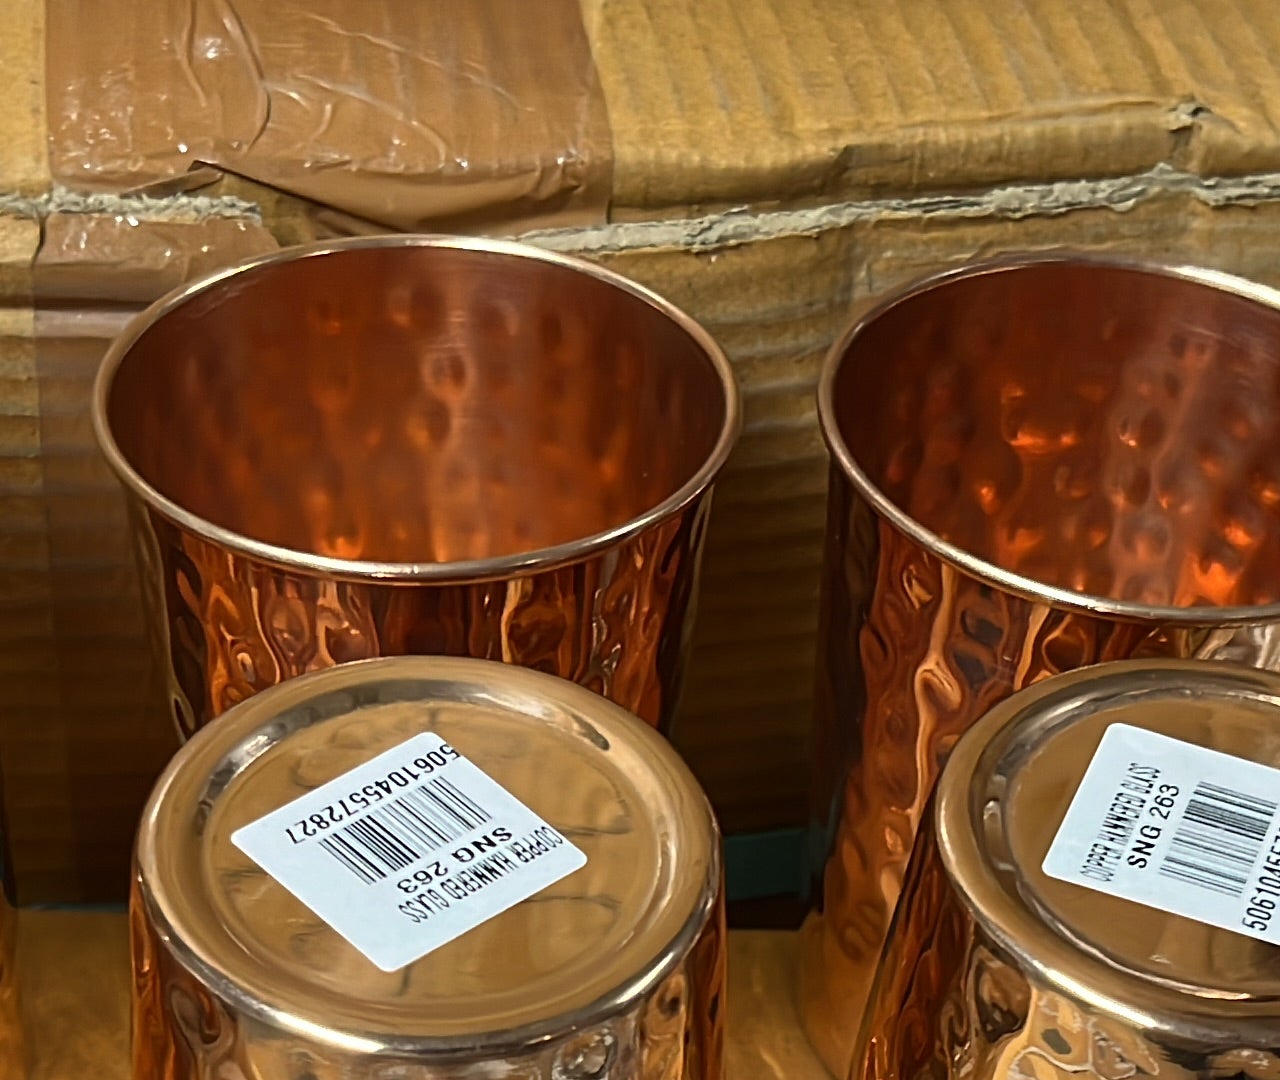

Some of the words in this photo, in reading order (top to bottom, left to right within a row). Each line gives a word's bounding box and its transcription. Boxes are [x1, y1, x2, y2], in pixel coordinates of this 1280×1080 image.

[285, 743, 461, 844] 5061045572827
[507, 826, 563, 863] COPPER
[1127, 824, 1162, 869] SNG
[1149, 783, 1180, 820] 263
[451, 827, 513, 863] SNG
[1080, 843, 1124, 881] COPPER
[397, 861, 449, 894] 263
[440, 850, 519, 900] HAMMERED
[398, 889, 451, 923] GLASS
